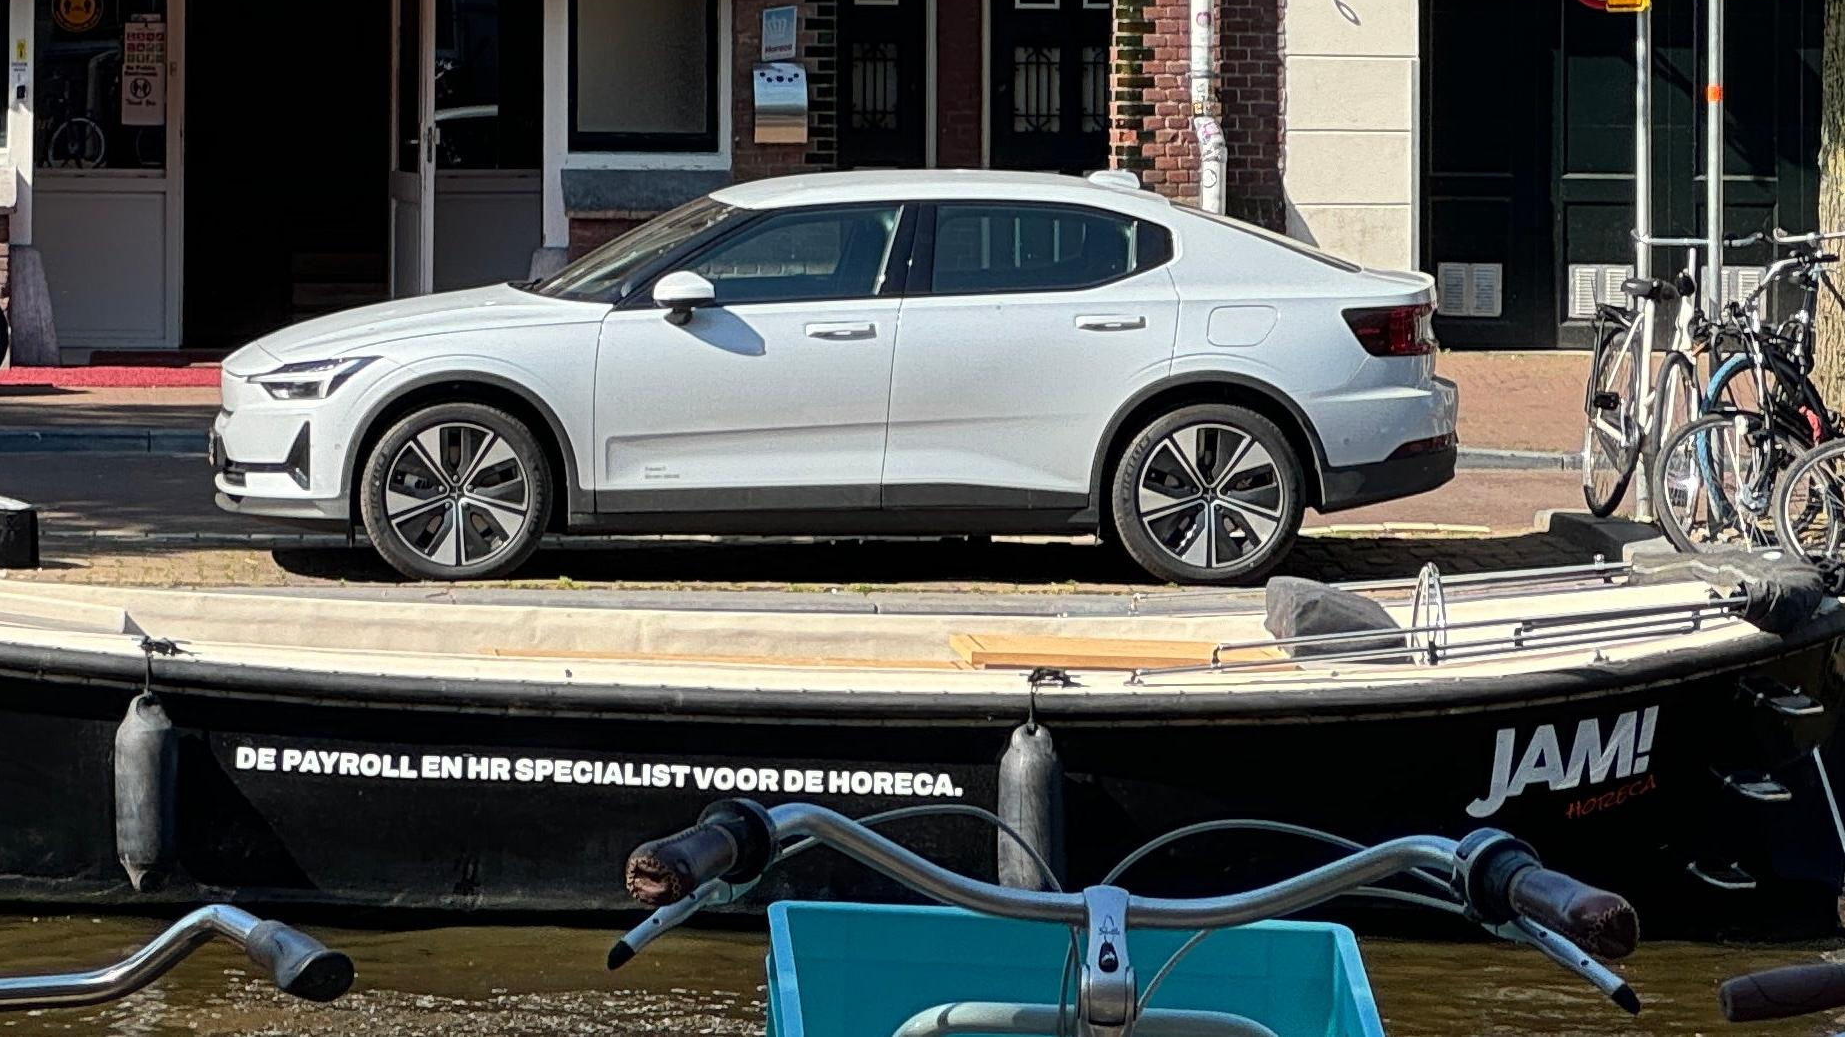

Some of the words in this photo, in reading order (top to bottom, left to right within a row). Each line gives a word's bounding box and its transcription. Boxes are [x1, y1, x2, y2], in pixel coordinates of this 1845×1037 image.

[236, 746, 277, 771] DE
[282, 749, 418, 779] PAYROLL
[421, 755, 463, 779] EN
[468, 756, 511, 781] HR
[515, 758, 691, 788] SPECIALIST
[693, 766, 780, 792] VOOR
[783, 768, 825, 793] DE
[829, 770, 964, 797] HORECA.
[1465, 705, 1660, 819] JAM!
[1564, 773, 1657, 820] HORECA
